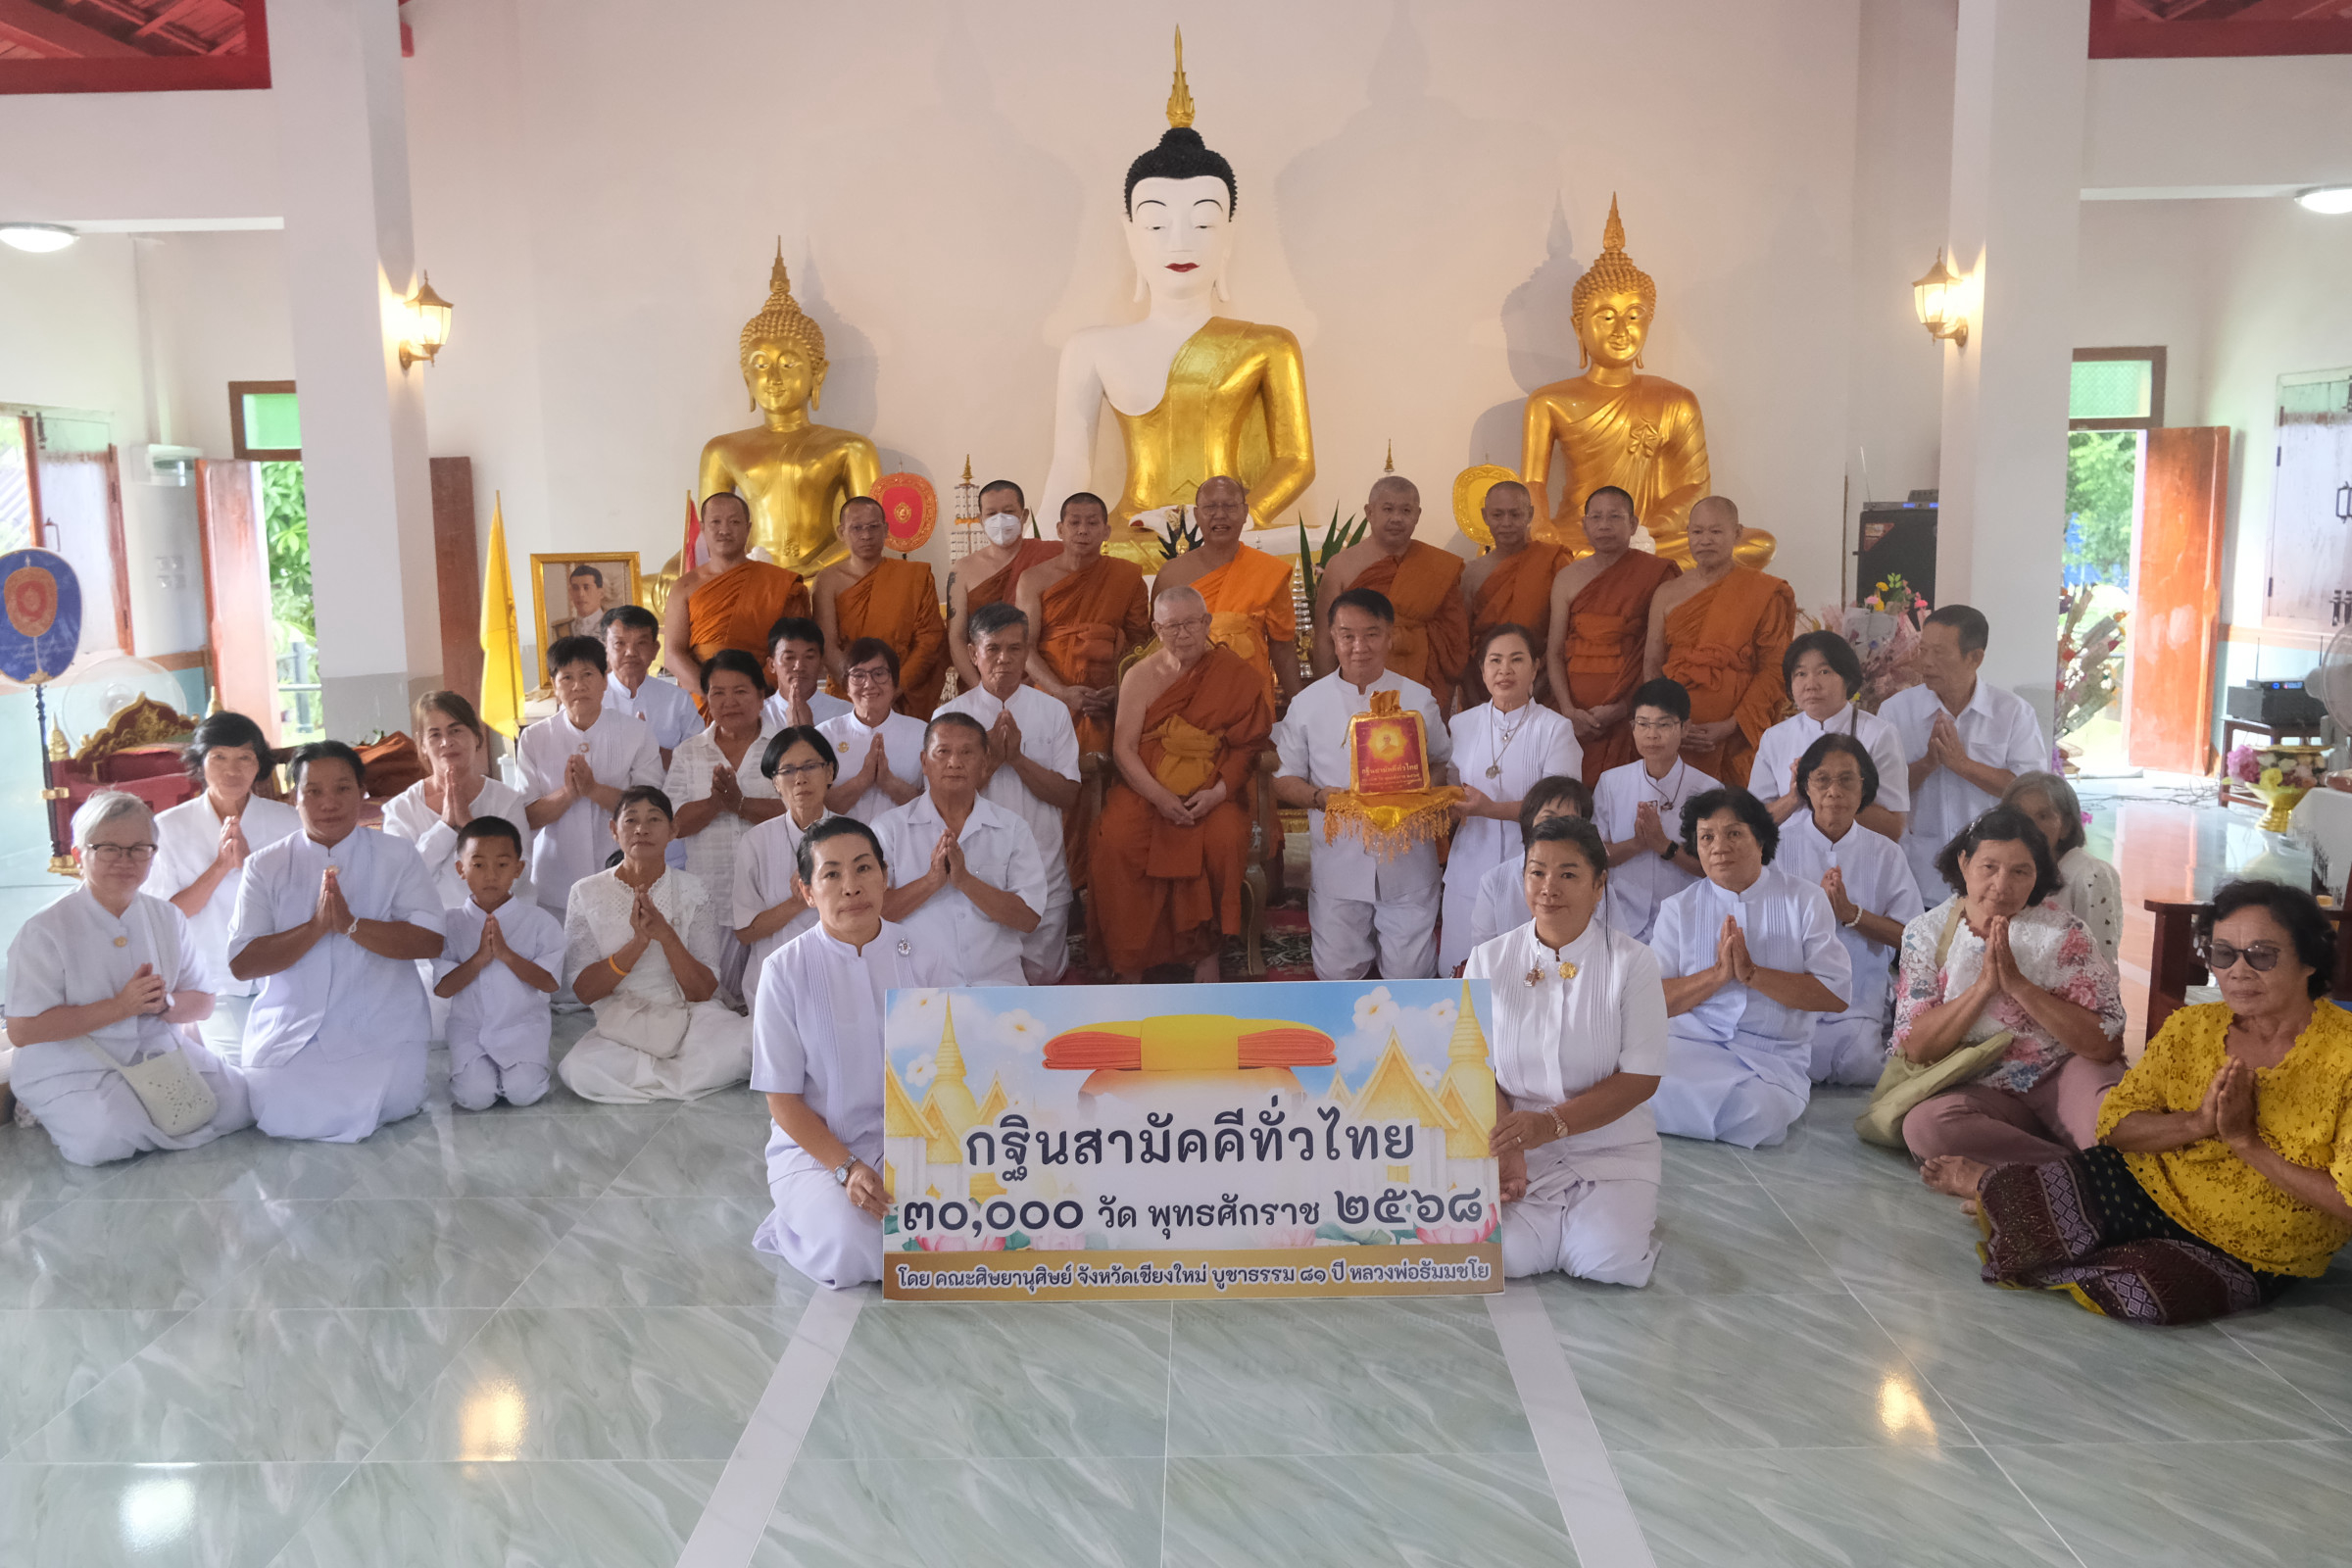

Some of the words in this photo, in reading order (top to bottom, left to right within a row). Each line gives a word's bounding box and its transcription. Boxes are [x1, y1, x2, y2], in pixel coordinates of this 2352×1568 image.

[965, 1094, 1414, 1182] กฐินสามัคคีทั่วไทย
[903, 1200, 1084, 1238] ๓๐,๐๐๐
[1098, 1194, 1137, 1229] วัด
[1148, 1193, 1320, 1241] พุทธศักราช
[1333, 1187, 1483, 1225] ๒๕๖๘
[897, 1266, 930, 1287] โดย
[935, 1262, 1072, 1293] คณะศิษยานุศิษย์
[1077, 1262, 1206, 1285] จังหวัดเชียงใหม่
[1212, 1266, 1295, 1290] บูชาธรรม
[1299, 1266, 1326, 1284] ๘๑
[1331, 1260, 1346, 1282] ปี
[1349, 1258, 1490, 1281] หลวงพ่อธัมมชโย
